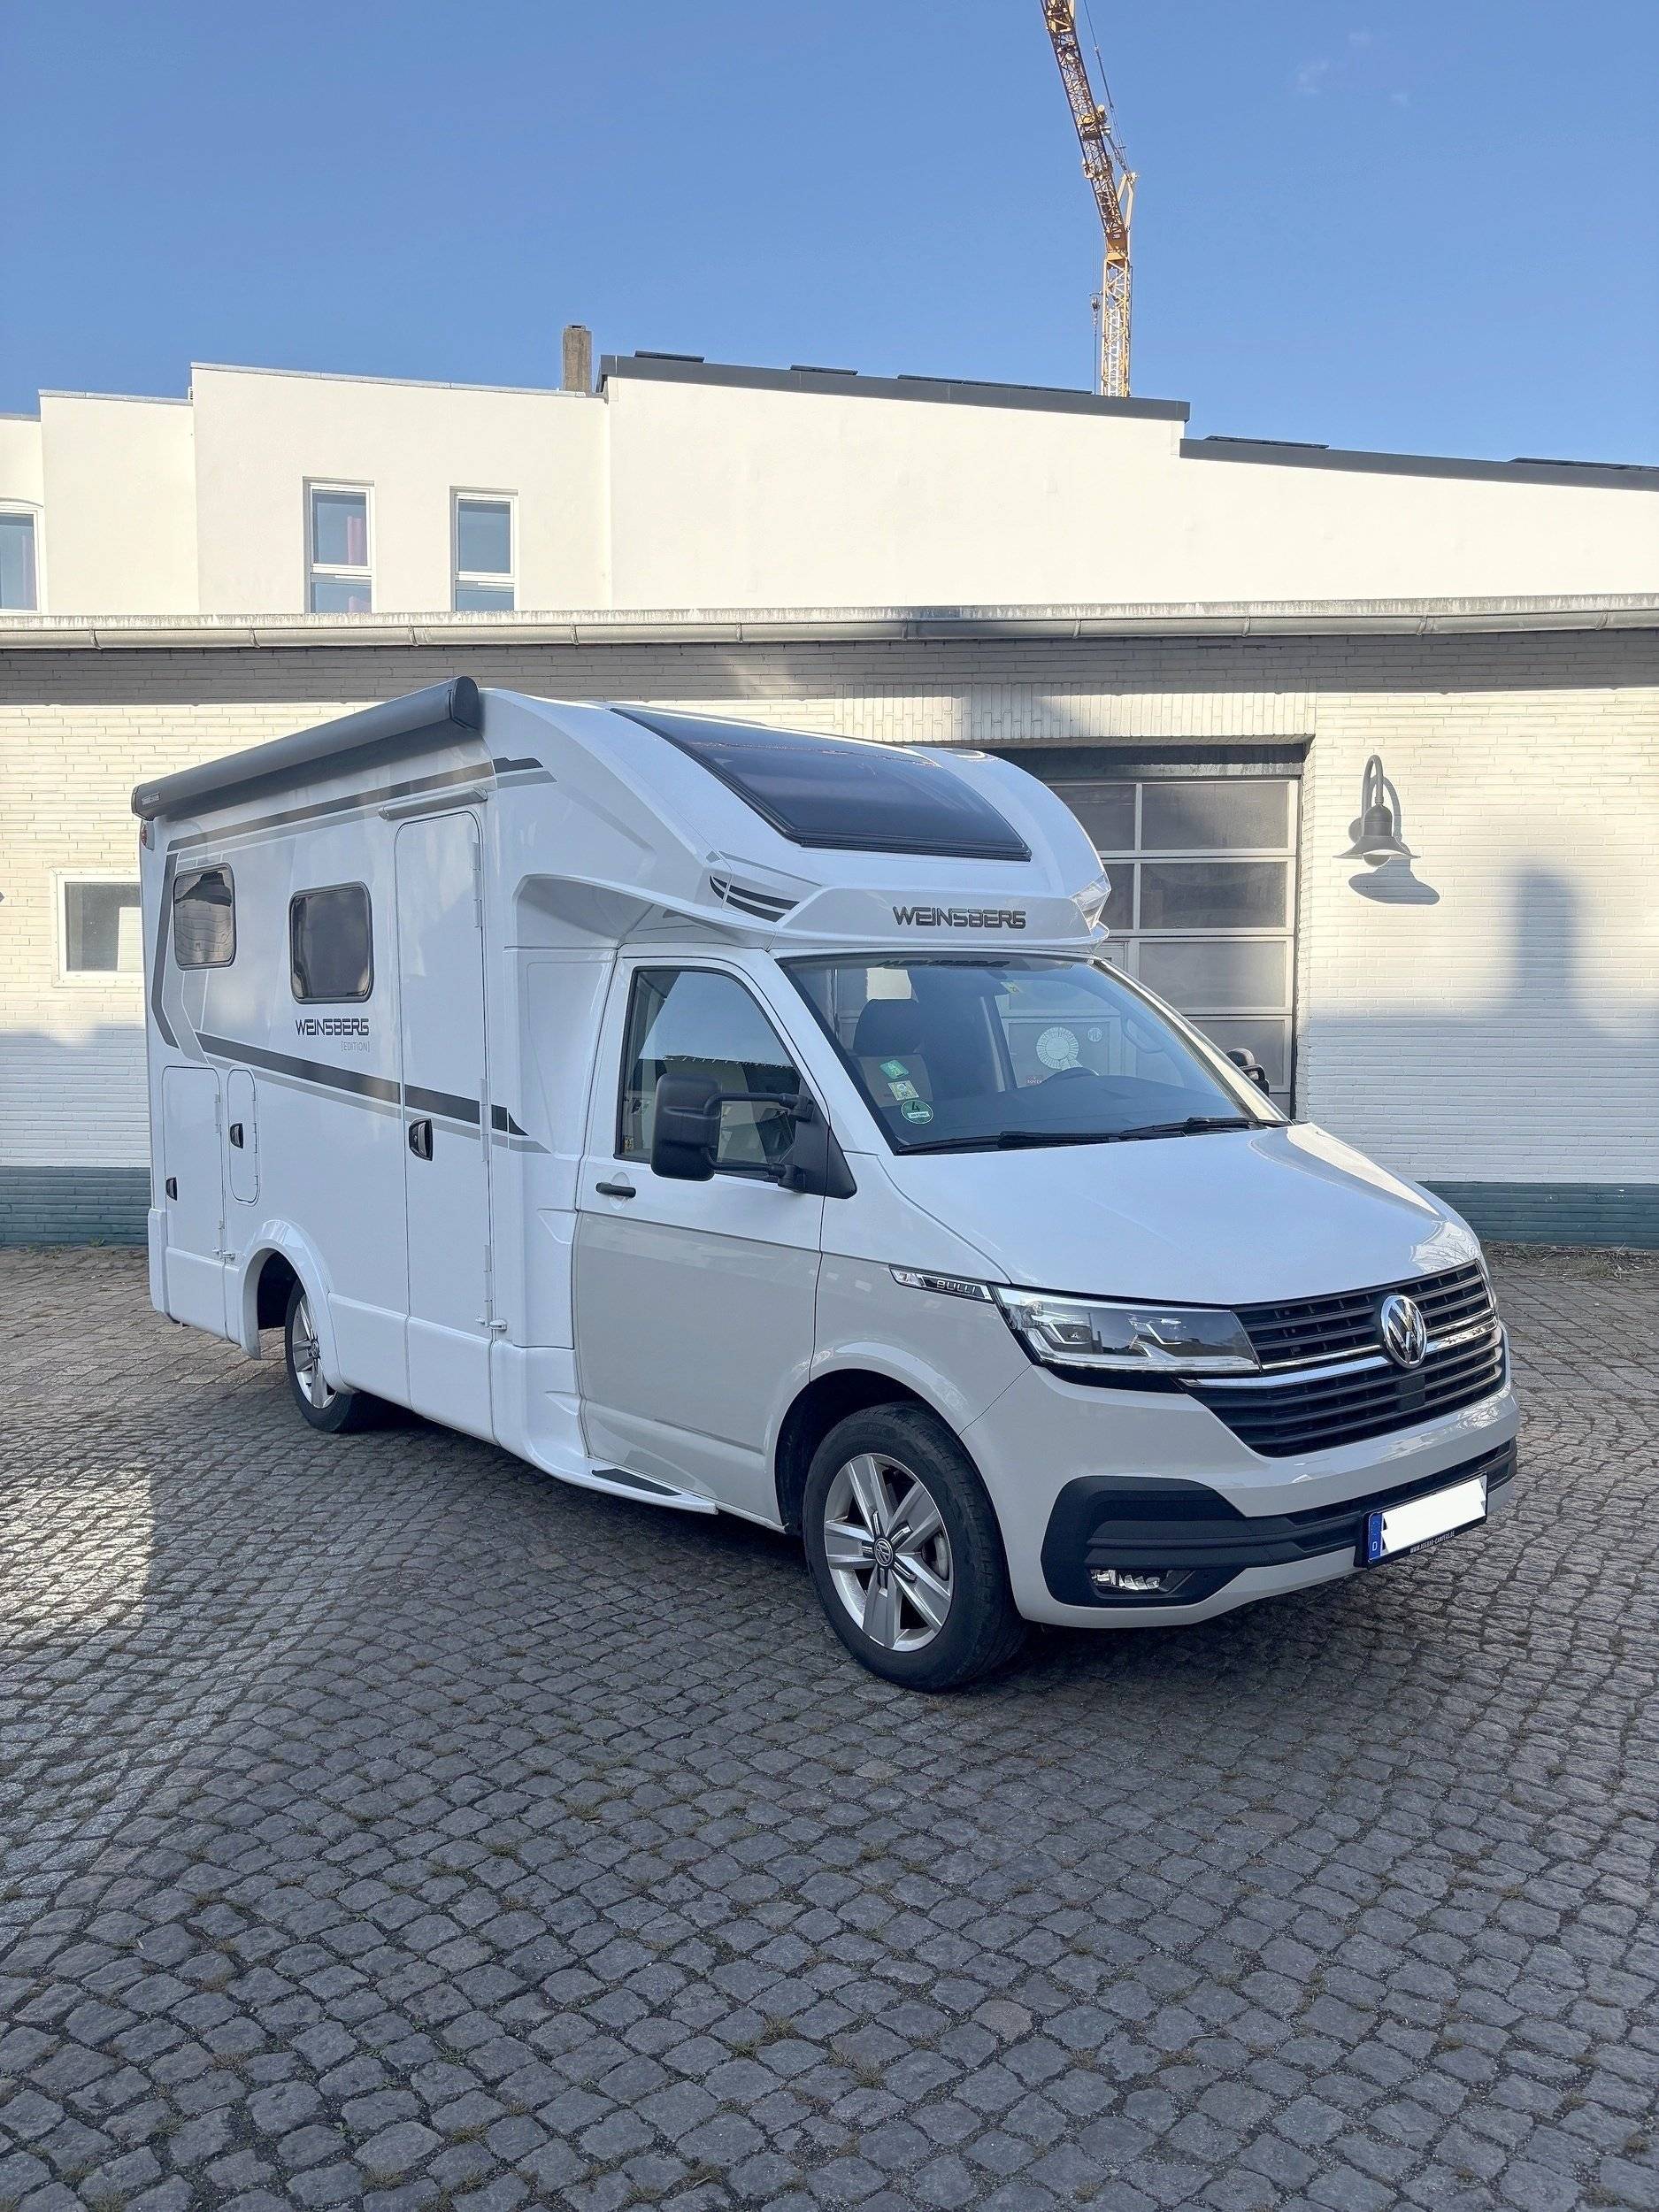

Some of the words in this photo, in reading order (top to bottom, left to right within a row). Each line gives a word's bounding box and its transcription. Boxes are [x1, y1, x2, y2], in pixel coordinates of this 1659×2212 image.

[893, 906, 1026, 929] WEINSBERG
[295, 1018, 369, 1036] WEINSBERG
[911, 1101, 921, 1111] 4
[936, 1279, 976, 1294] BULLI
[1371, 1541, 1378, 1551] D
